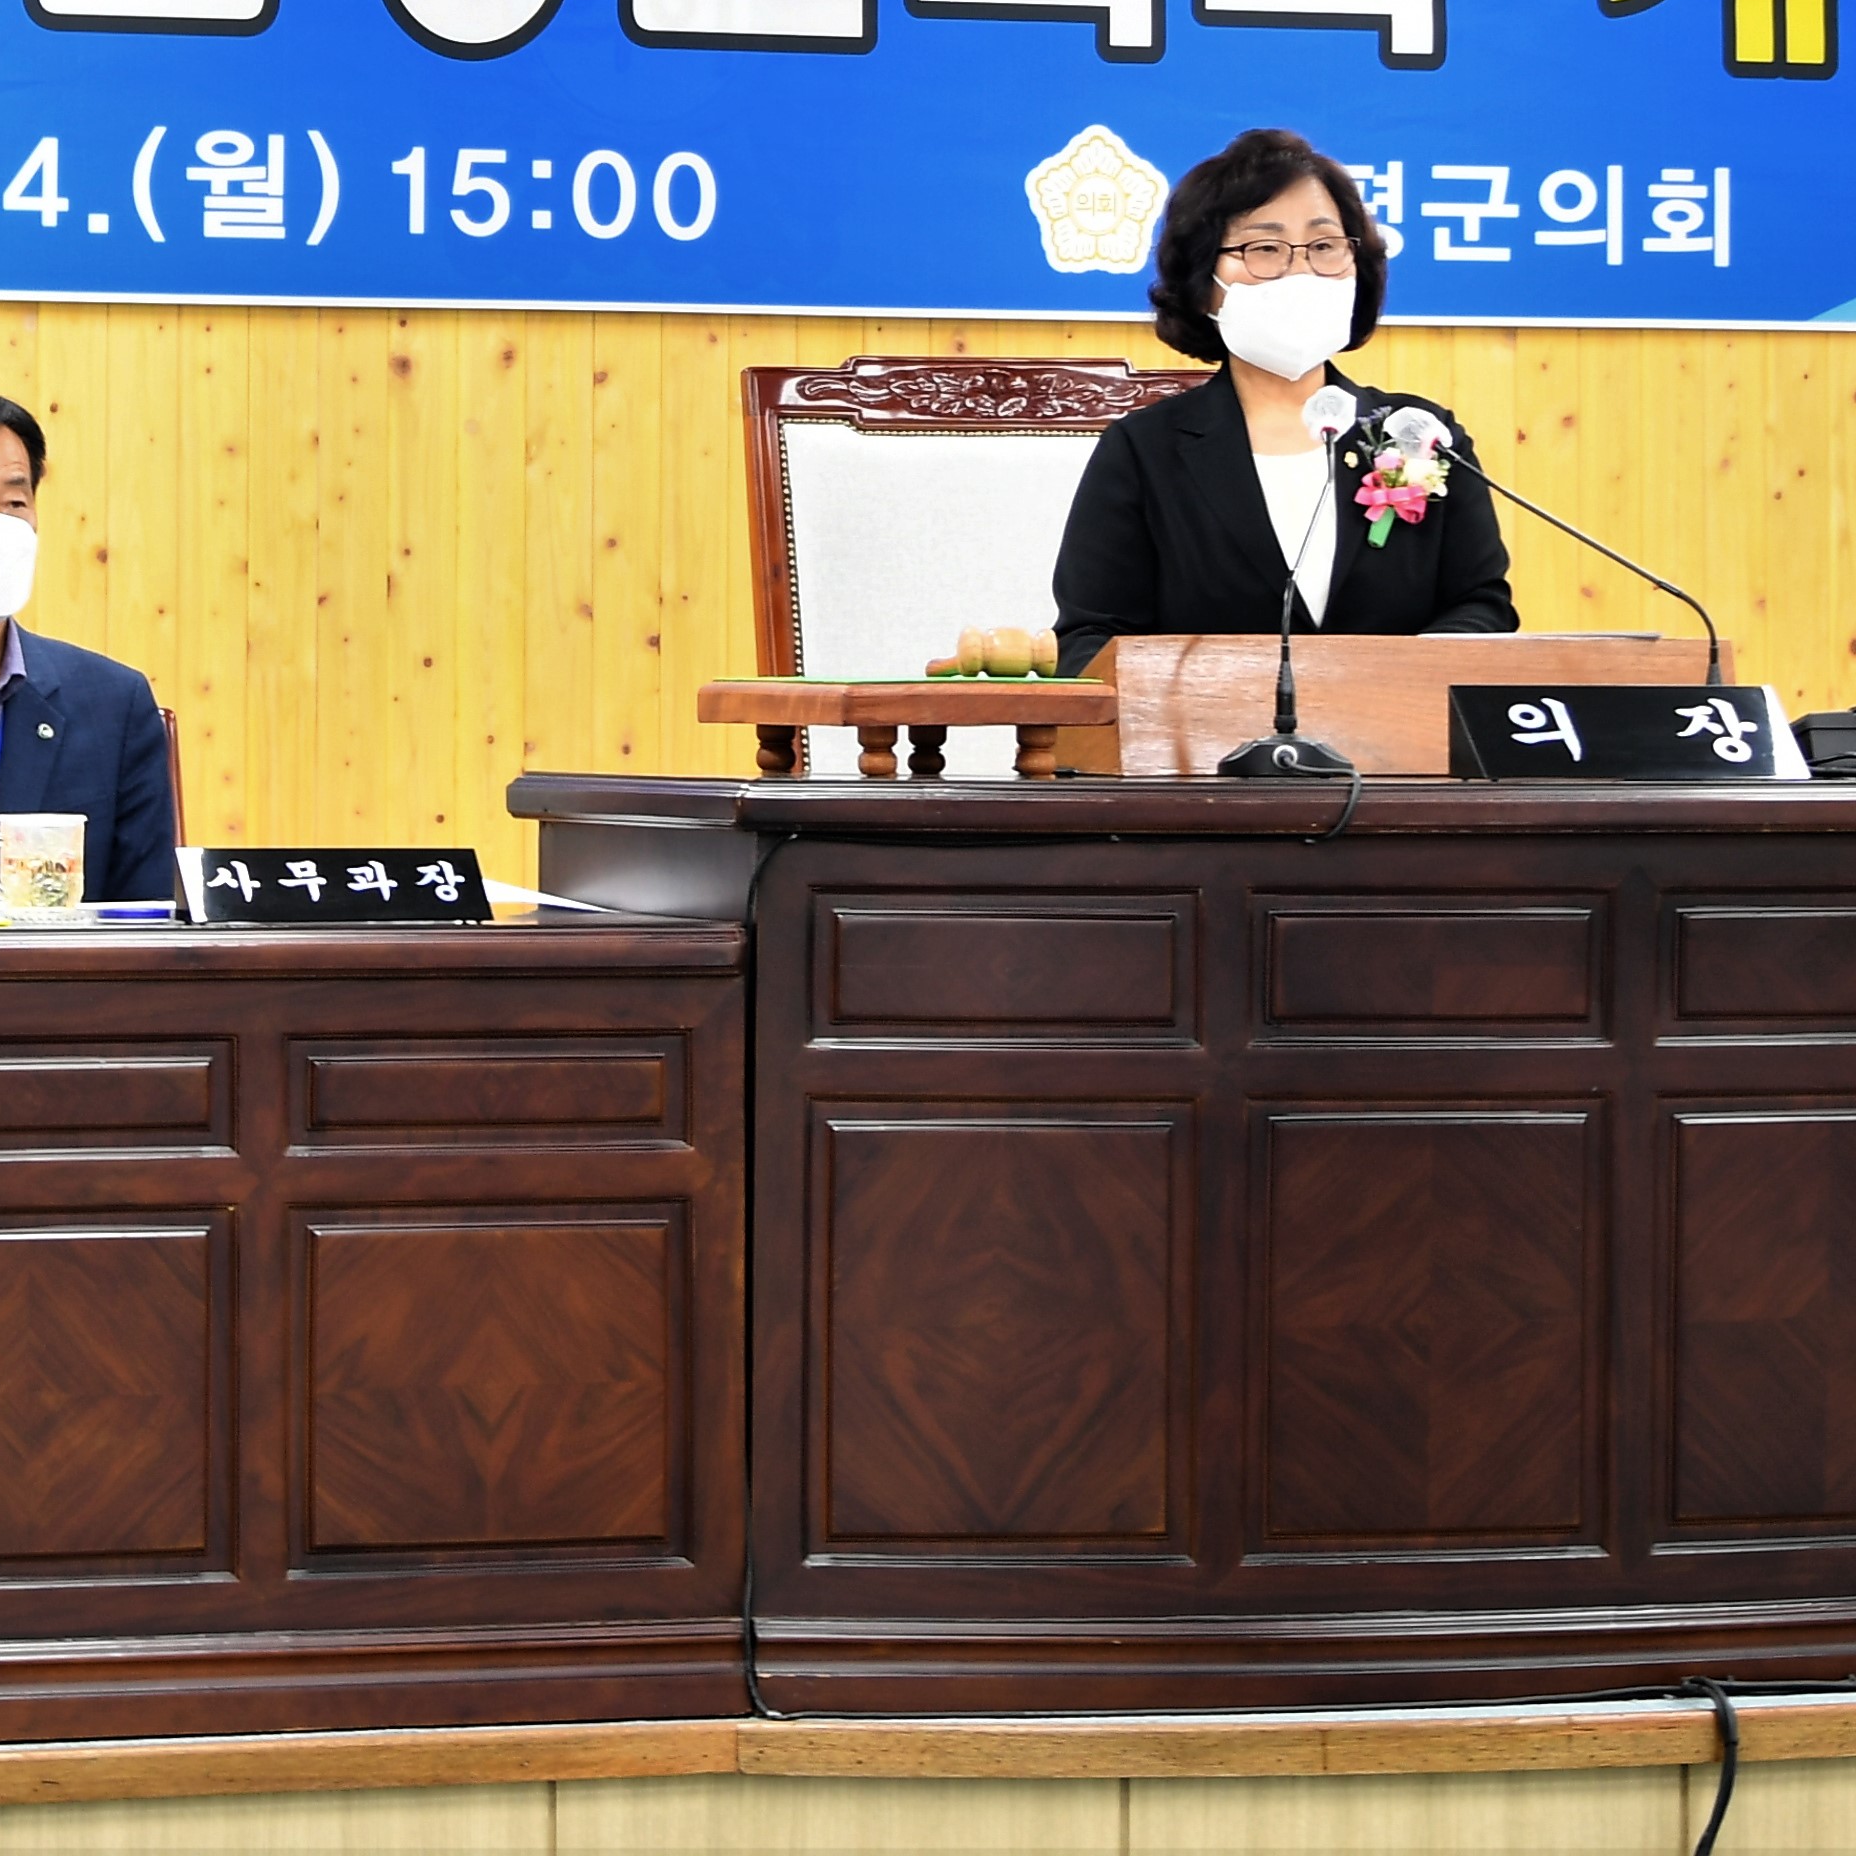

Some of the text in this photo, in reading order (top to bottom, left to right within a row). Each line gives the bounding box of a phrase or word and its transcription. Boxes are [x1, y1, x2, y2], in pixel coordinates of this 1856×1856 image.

[390, 145, 718, 241] 15:00
[1075, 191, 1117, 218] 의회
[1344, 160, 1731, 268] 평군의회
